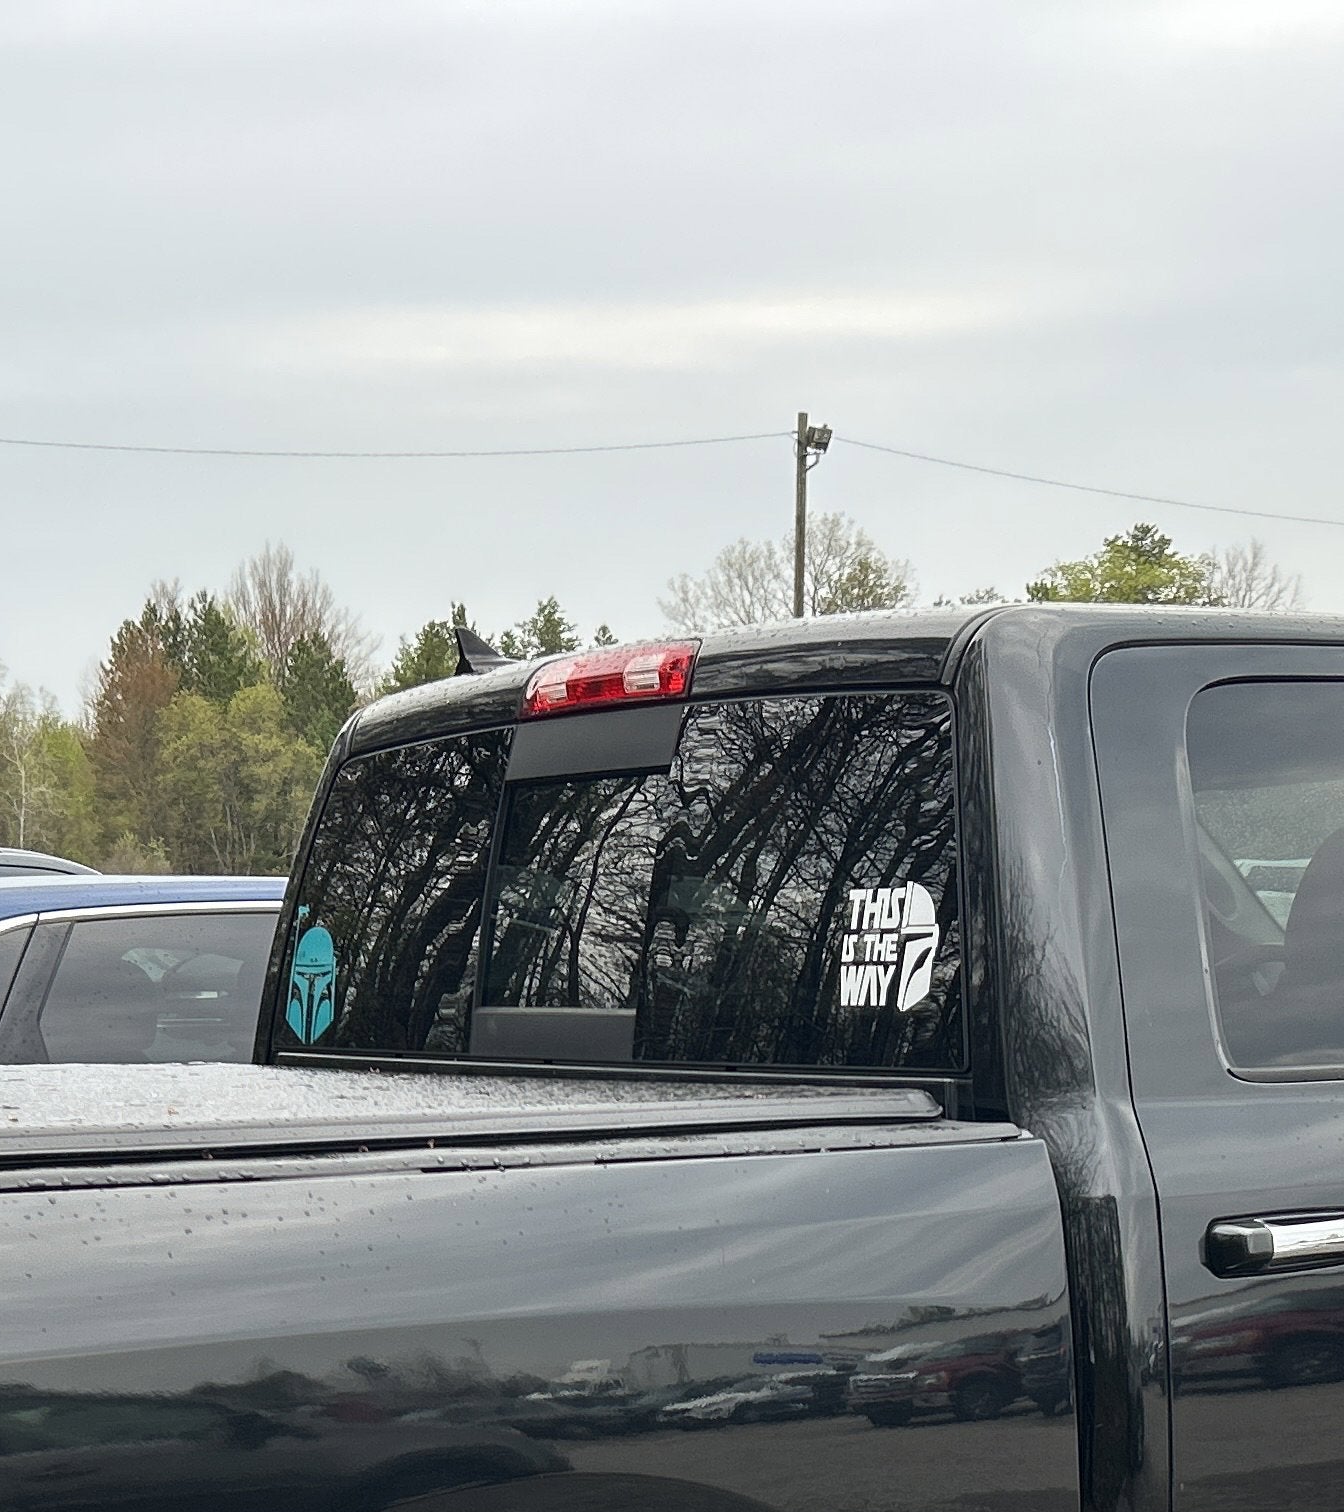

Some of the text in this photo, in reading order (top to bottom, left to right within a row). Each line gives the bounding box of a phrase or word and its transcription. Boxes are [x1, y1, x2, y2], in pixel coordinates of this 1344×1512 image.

[849, 887, 906, 930] THIS
[841, 933, 898, 962] IS THE
[840, 965, 896, 1007] WAY
